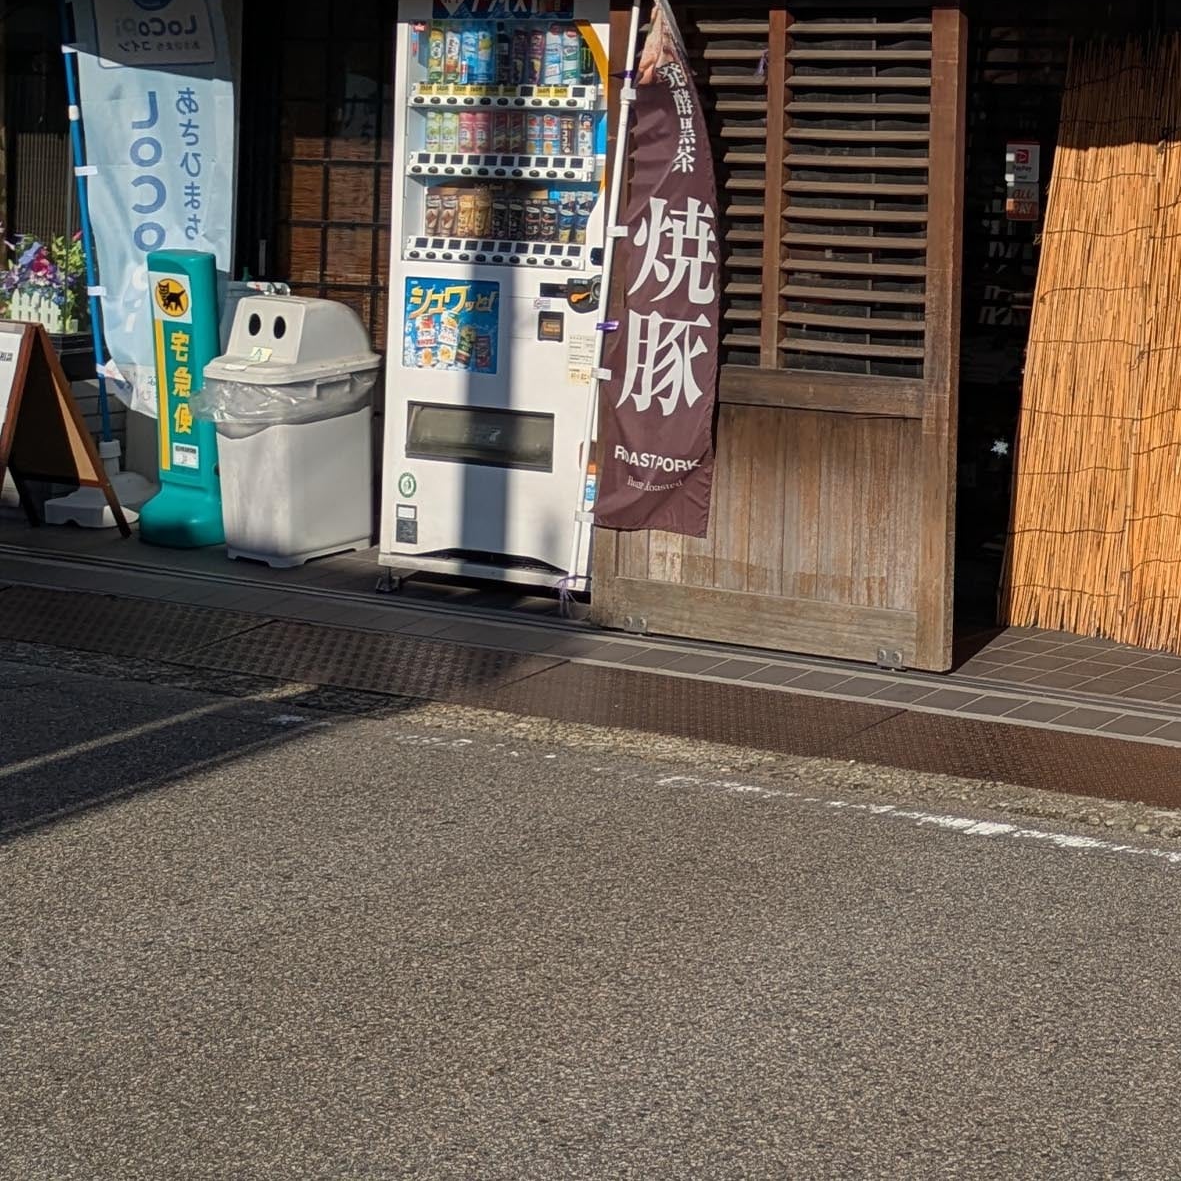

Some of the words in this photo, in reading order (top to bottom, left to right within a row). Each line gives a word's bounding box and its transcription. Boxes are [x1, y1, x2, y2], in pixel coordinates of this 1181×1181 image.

[657, 62, 697, 173] 発酵黒茶
[616, 197, 716, 417] 焼豚
[170, 330, 193, 434] 宅急便
